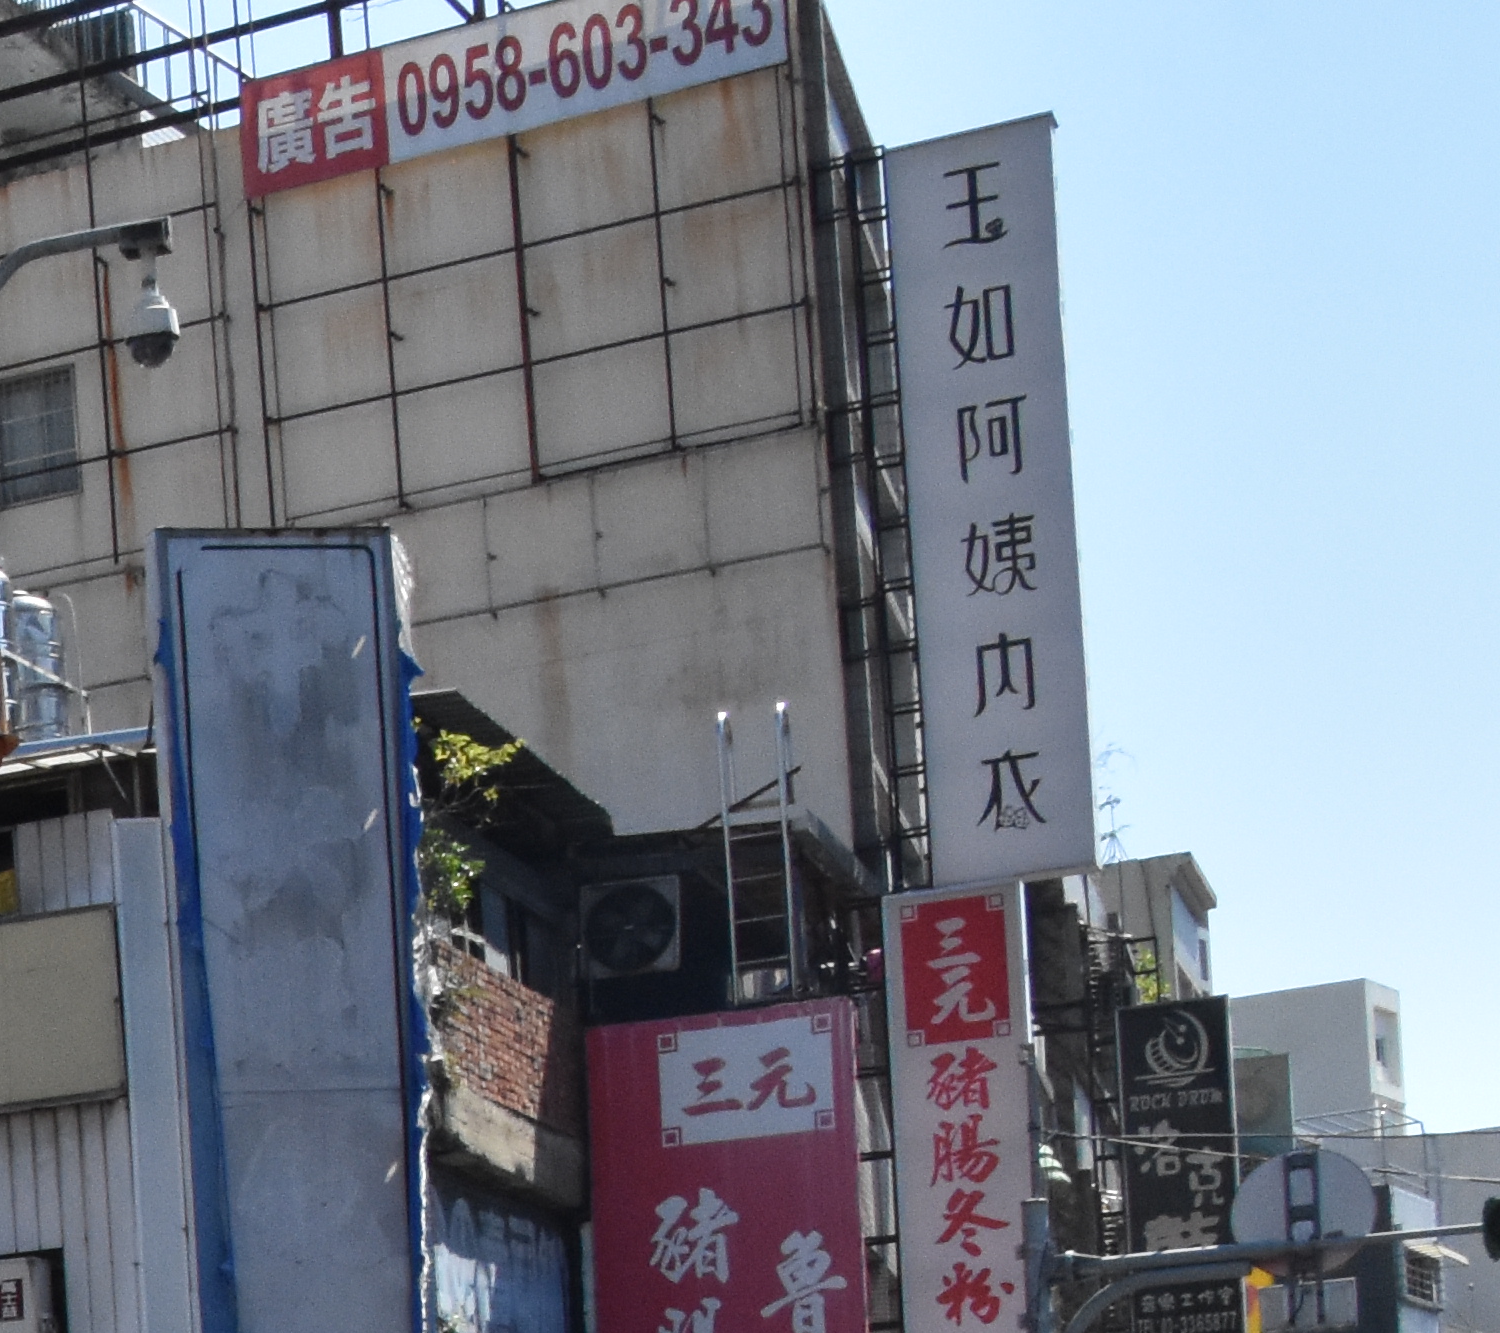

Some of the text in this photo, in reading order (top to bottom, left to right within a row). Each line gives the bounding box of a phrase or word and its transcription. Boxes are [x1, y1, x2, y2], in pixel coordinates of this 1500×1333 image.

[256, 0, 773, 174] 廣告 0958-603-343
[926, 915, 996, 1025] 三元
[681, 1046, 817, 1117] 三元
[925, 1047, 1015, 1327] 豬腸冬粉
